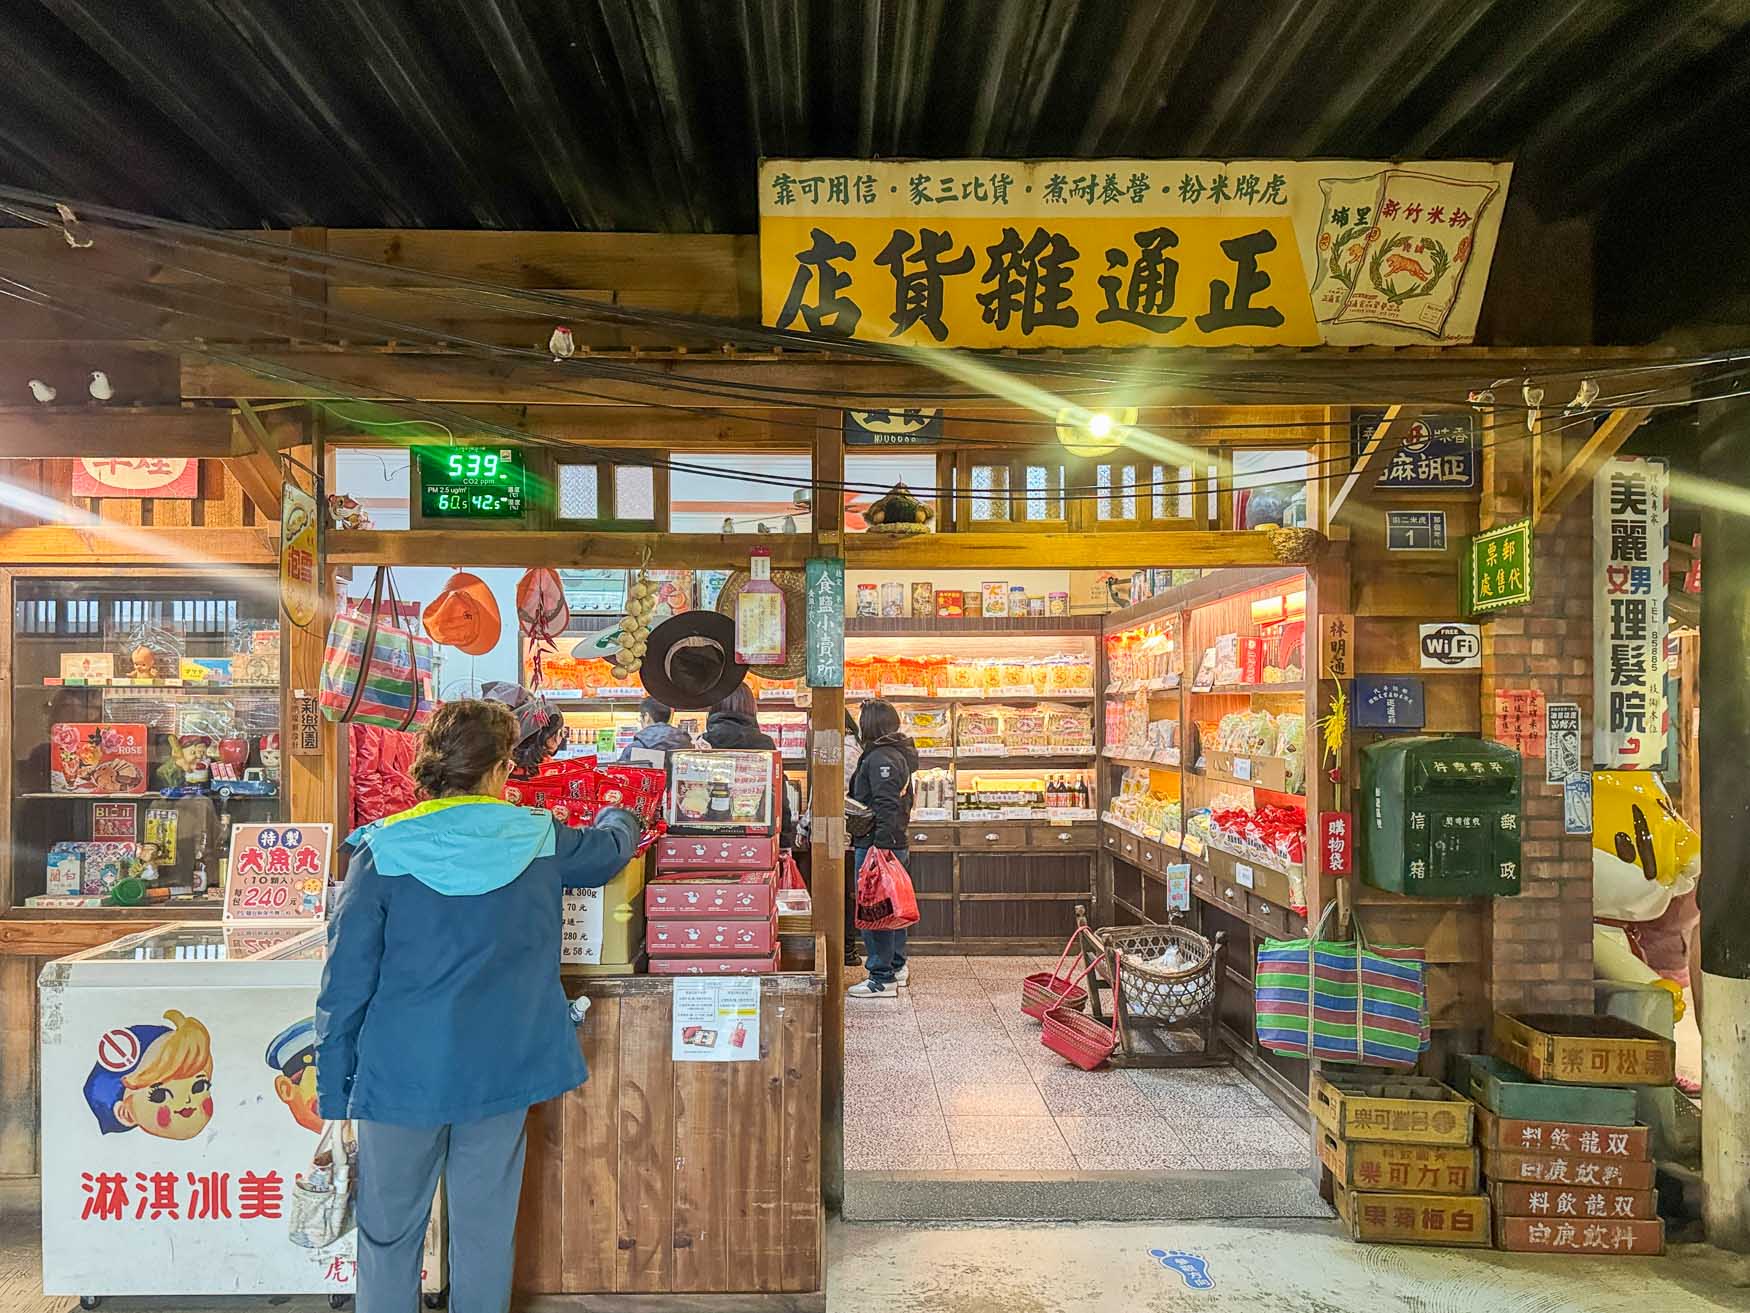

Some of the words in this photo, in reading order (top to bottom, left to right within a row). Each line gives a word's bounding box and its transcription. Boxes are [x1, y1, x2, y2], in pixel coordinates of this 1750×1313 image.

[1331, 206, 1371, 228] 埔里
[1382, 199, 1472, 229] 新竹米粉
[778, 225, 1287, 341] 正通雜貨店
[449, 454, 498, 476] 539
[1405, 529, 1414, 546] 1
[1486, 538, 1516, 567] 郵票
[1480, 567, 1523, 598] 代售處
[1329, 621, 1347, 676] 林明通
[118, 746, 143, 755] ROSE
[261, 831, 300, 847] 特製
[1327, 819, 1346, 872] 購物袋
[1500, 813, 1517, 880] 郵政
[239, 847, 321, 873] 大魚丸
[243, 887, 287, 907] 240
[567, 903, 577, 912] 70
[563, 931, 577, 940] 280
[1528, 1191, 1635, 1217] 双龍飲料
